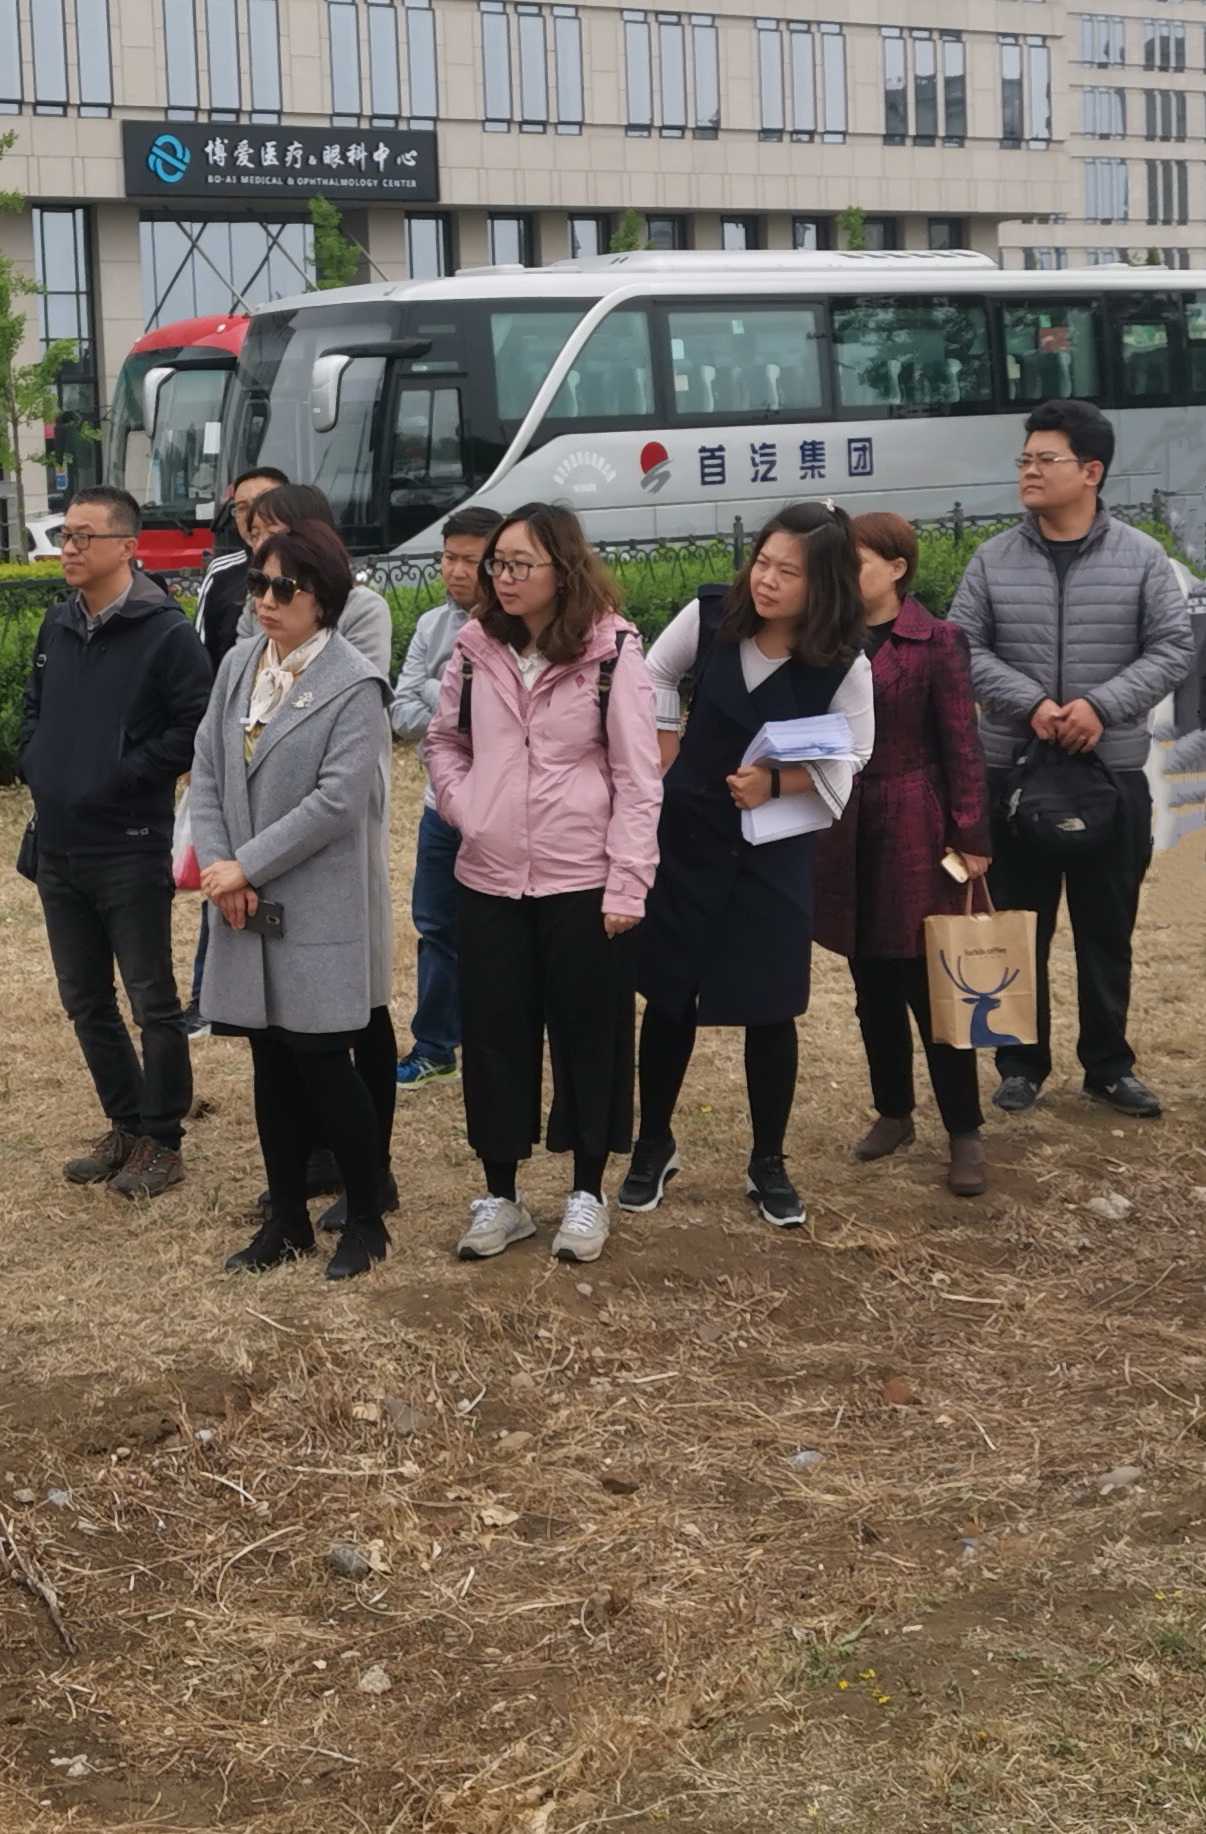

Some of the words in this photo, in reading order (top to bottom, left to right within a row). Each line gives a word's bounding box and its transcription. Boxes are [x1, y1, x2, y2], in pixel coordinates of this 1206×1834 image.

[241, 175, 284, 185] MEDICAL
[297, 177, 378, 187] OPHTHALMOLOGY
[382, 178, 417, 188] CENTER
[698, 437, 874, 486] 首汽集团
